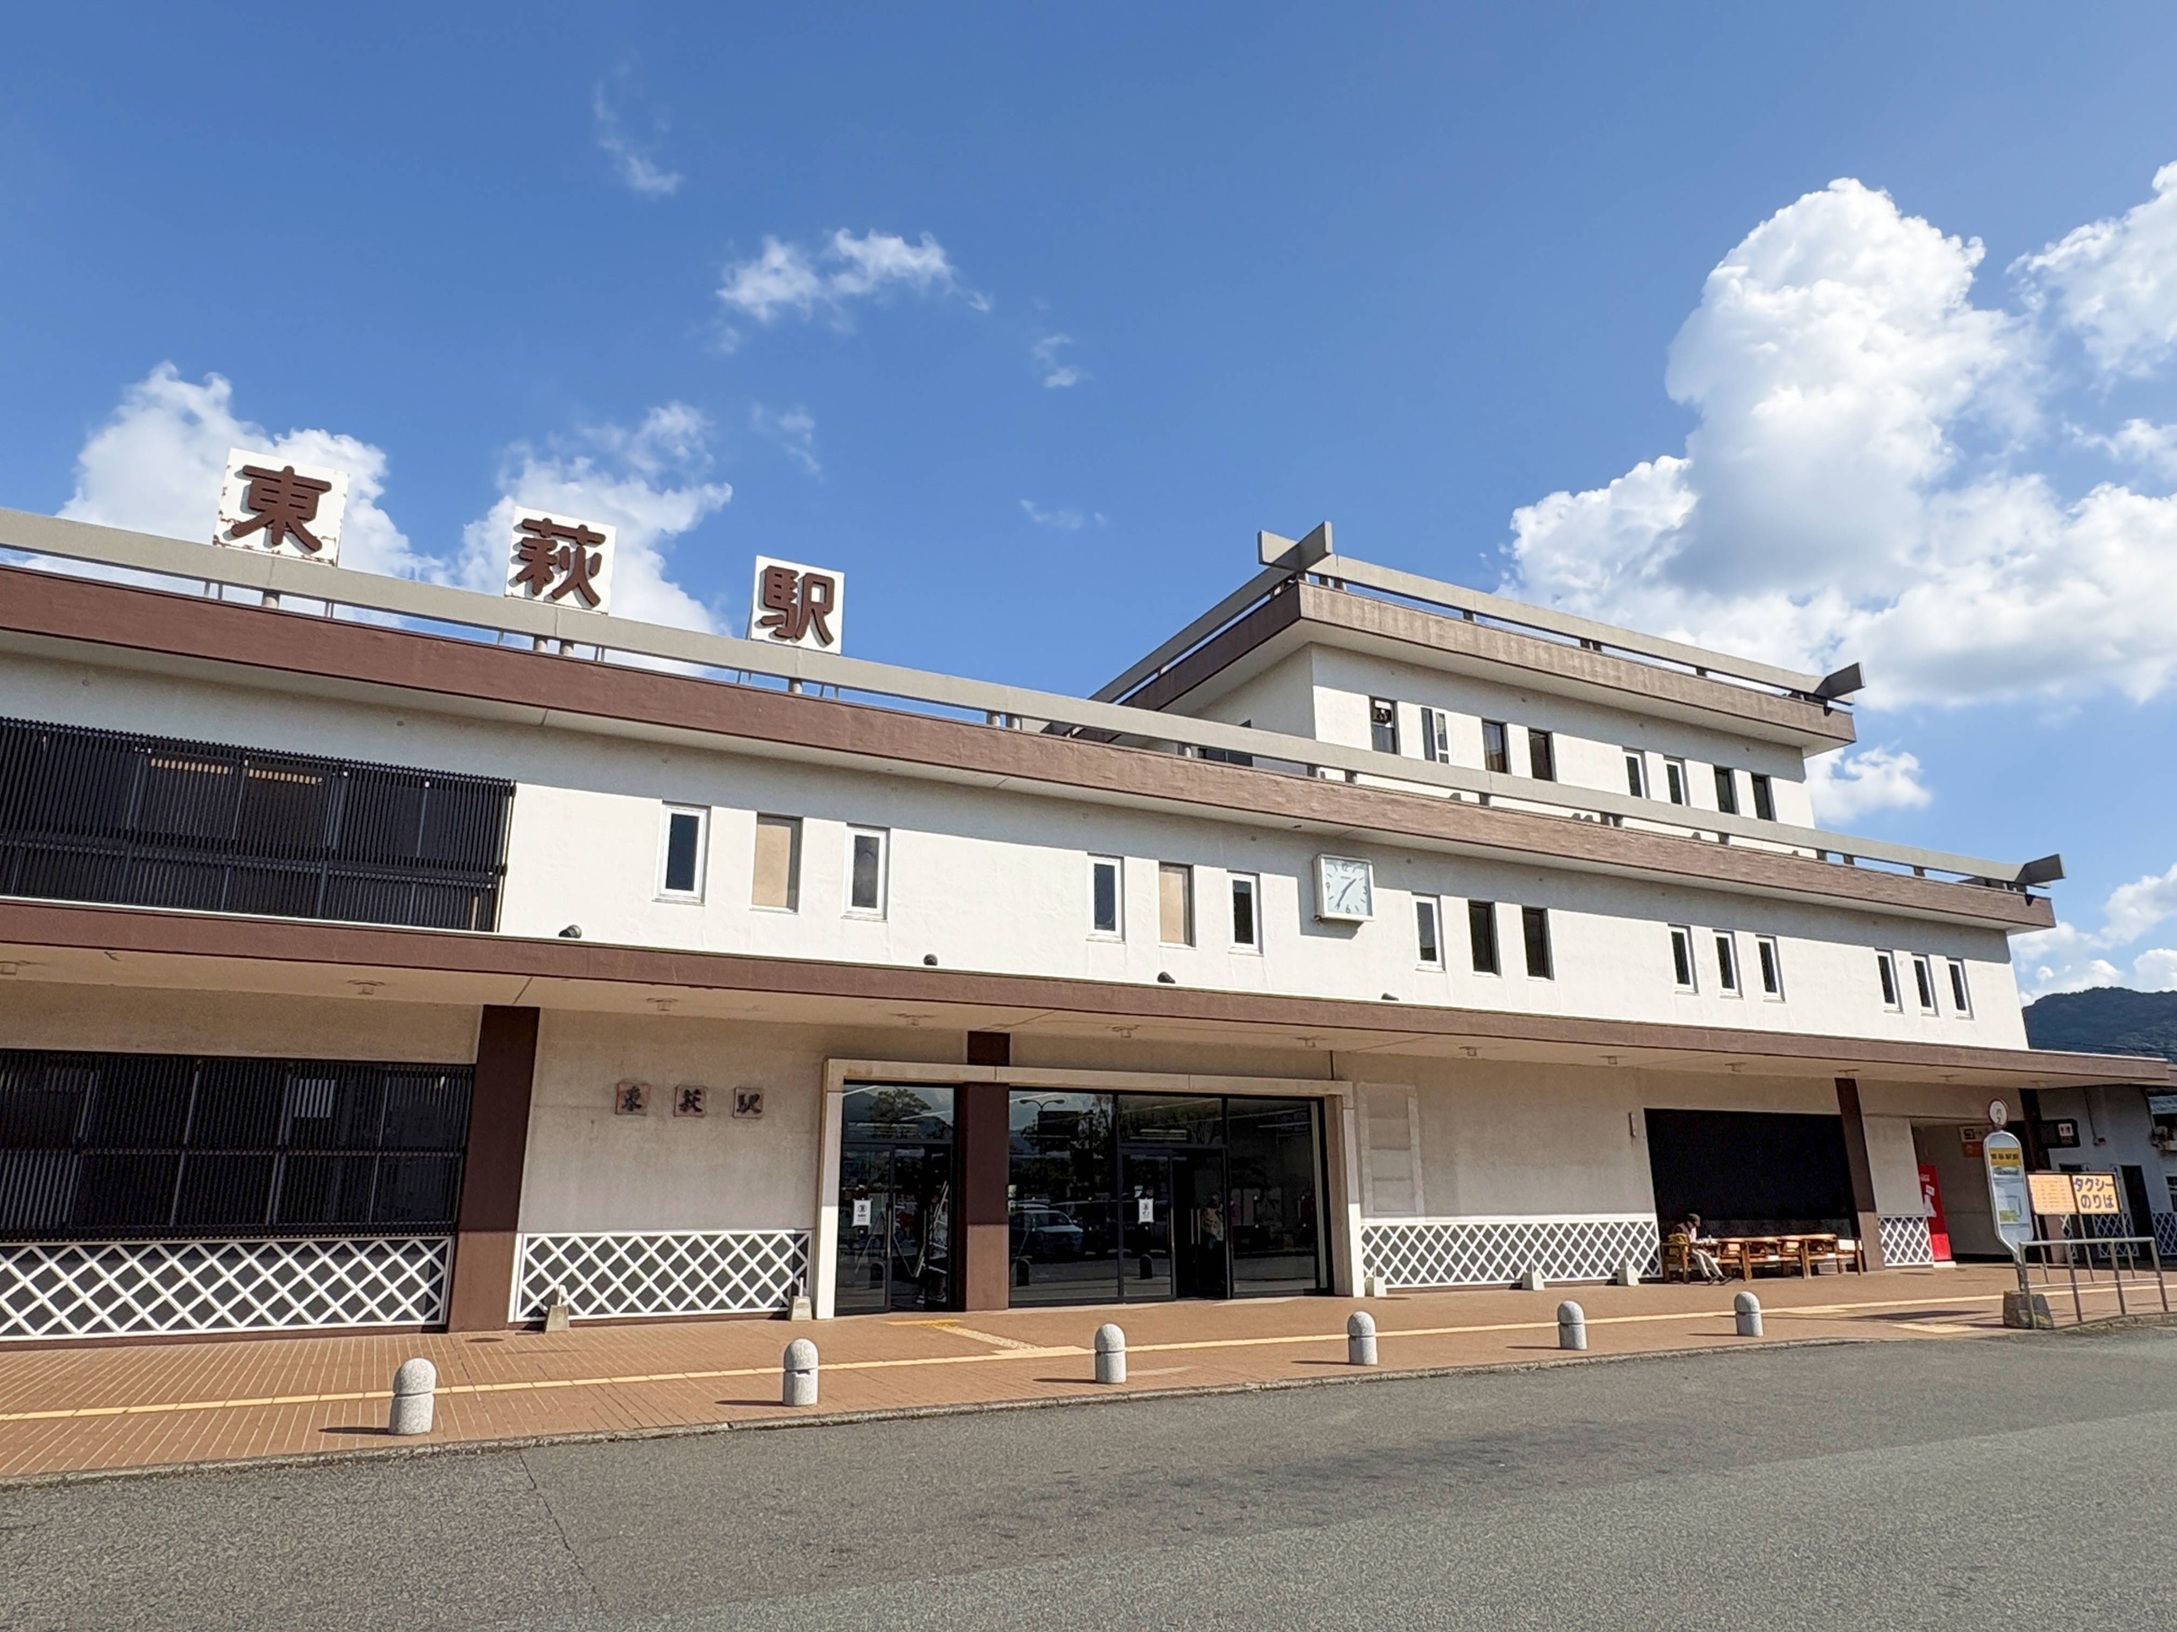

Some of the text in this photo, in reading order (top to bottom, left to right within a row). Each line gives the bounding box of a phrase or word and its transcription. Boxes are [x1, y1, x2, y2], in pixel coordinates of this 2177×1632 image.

[231, 465, 836, 646] 東萩駅
[2074, 1177, 2114, 1192] タクシー
